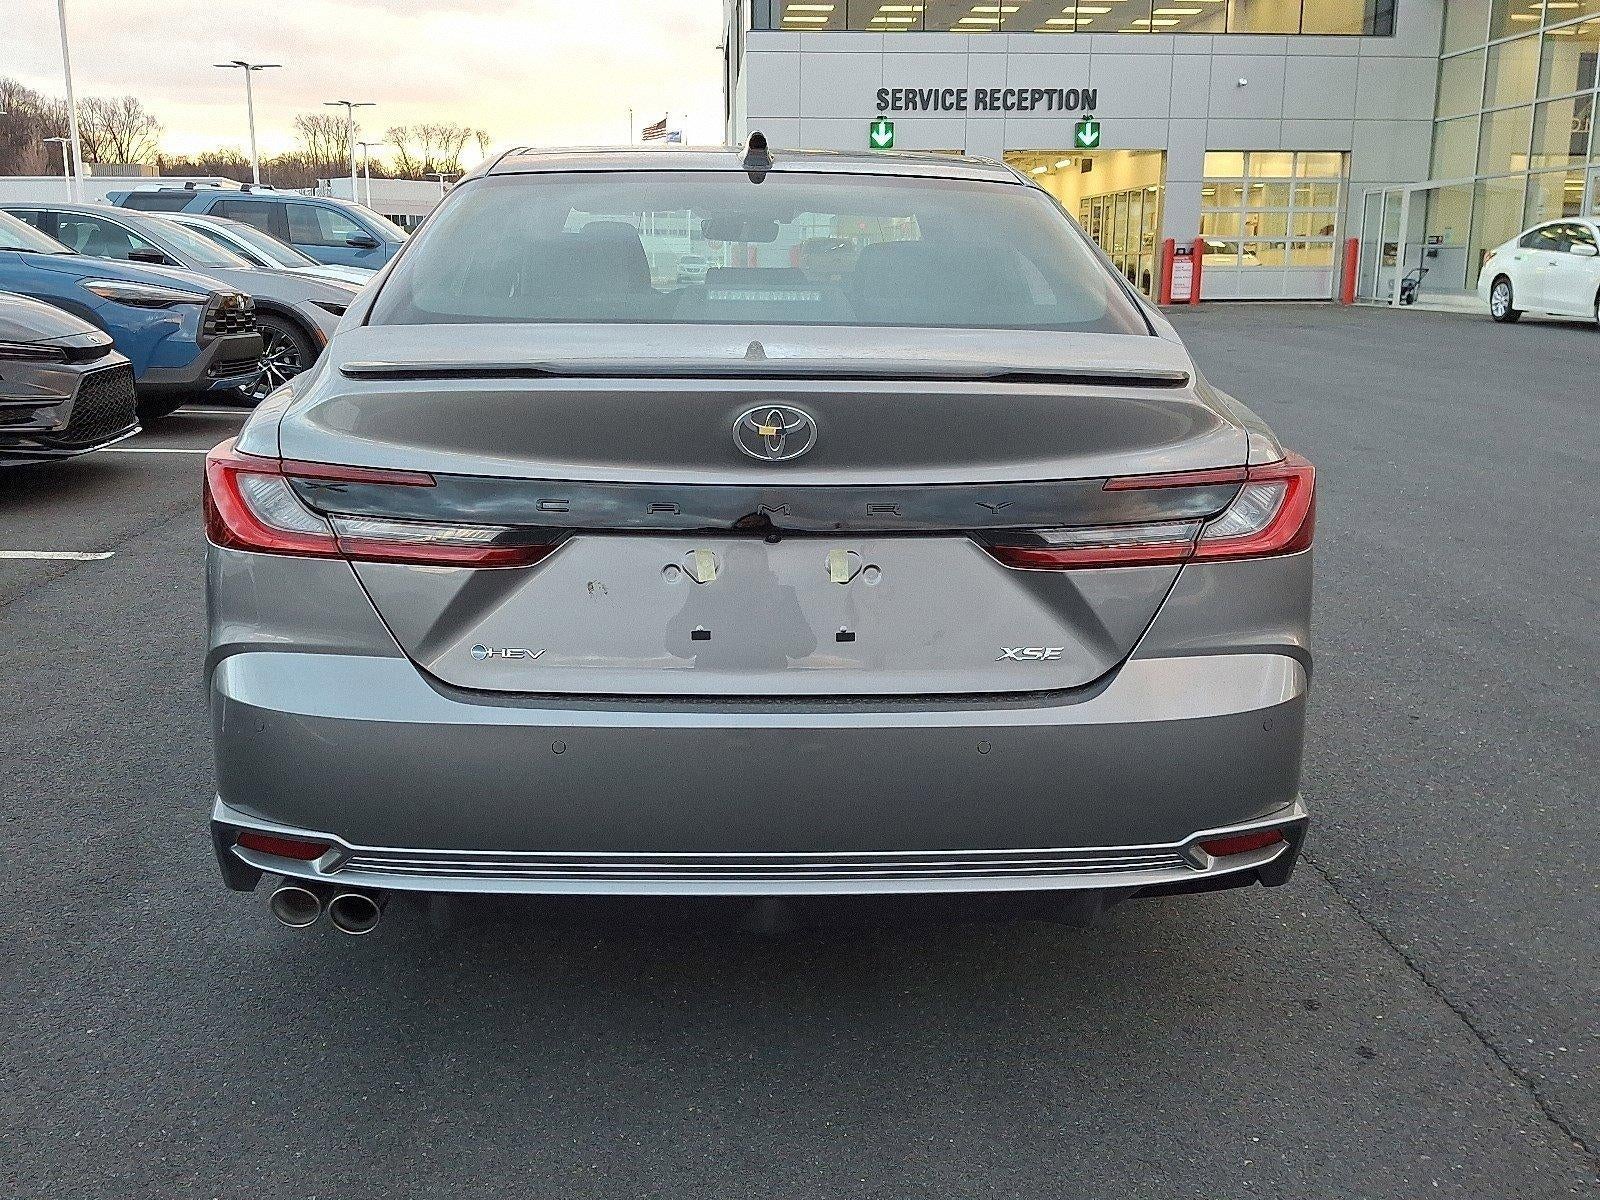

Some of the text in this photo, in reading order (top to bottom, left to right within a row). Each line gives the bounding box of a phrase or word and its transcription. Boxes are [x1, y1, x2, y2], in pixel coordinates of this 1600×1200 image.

[876, 88, 1098, 111] SERVICE RECEPTION
[536, 498, 1015, 515] CAMRY
[487, 646, 547, 660] HEV
[995, 646, 1065, 661] XSE
